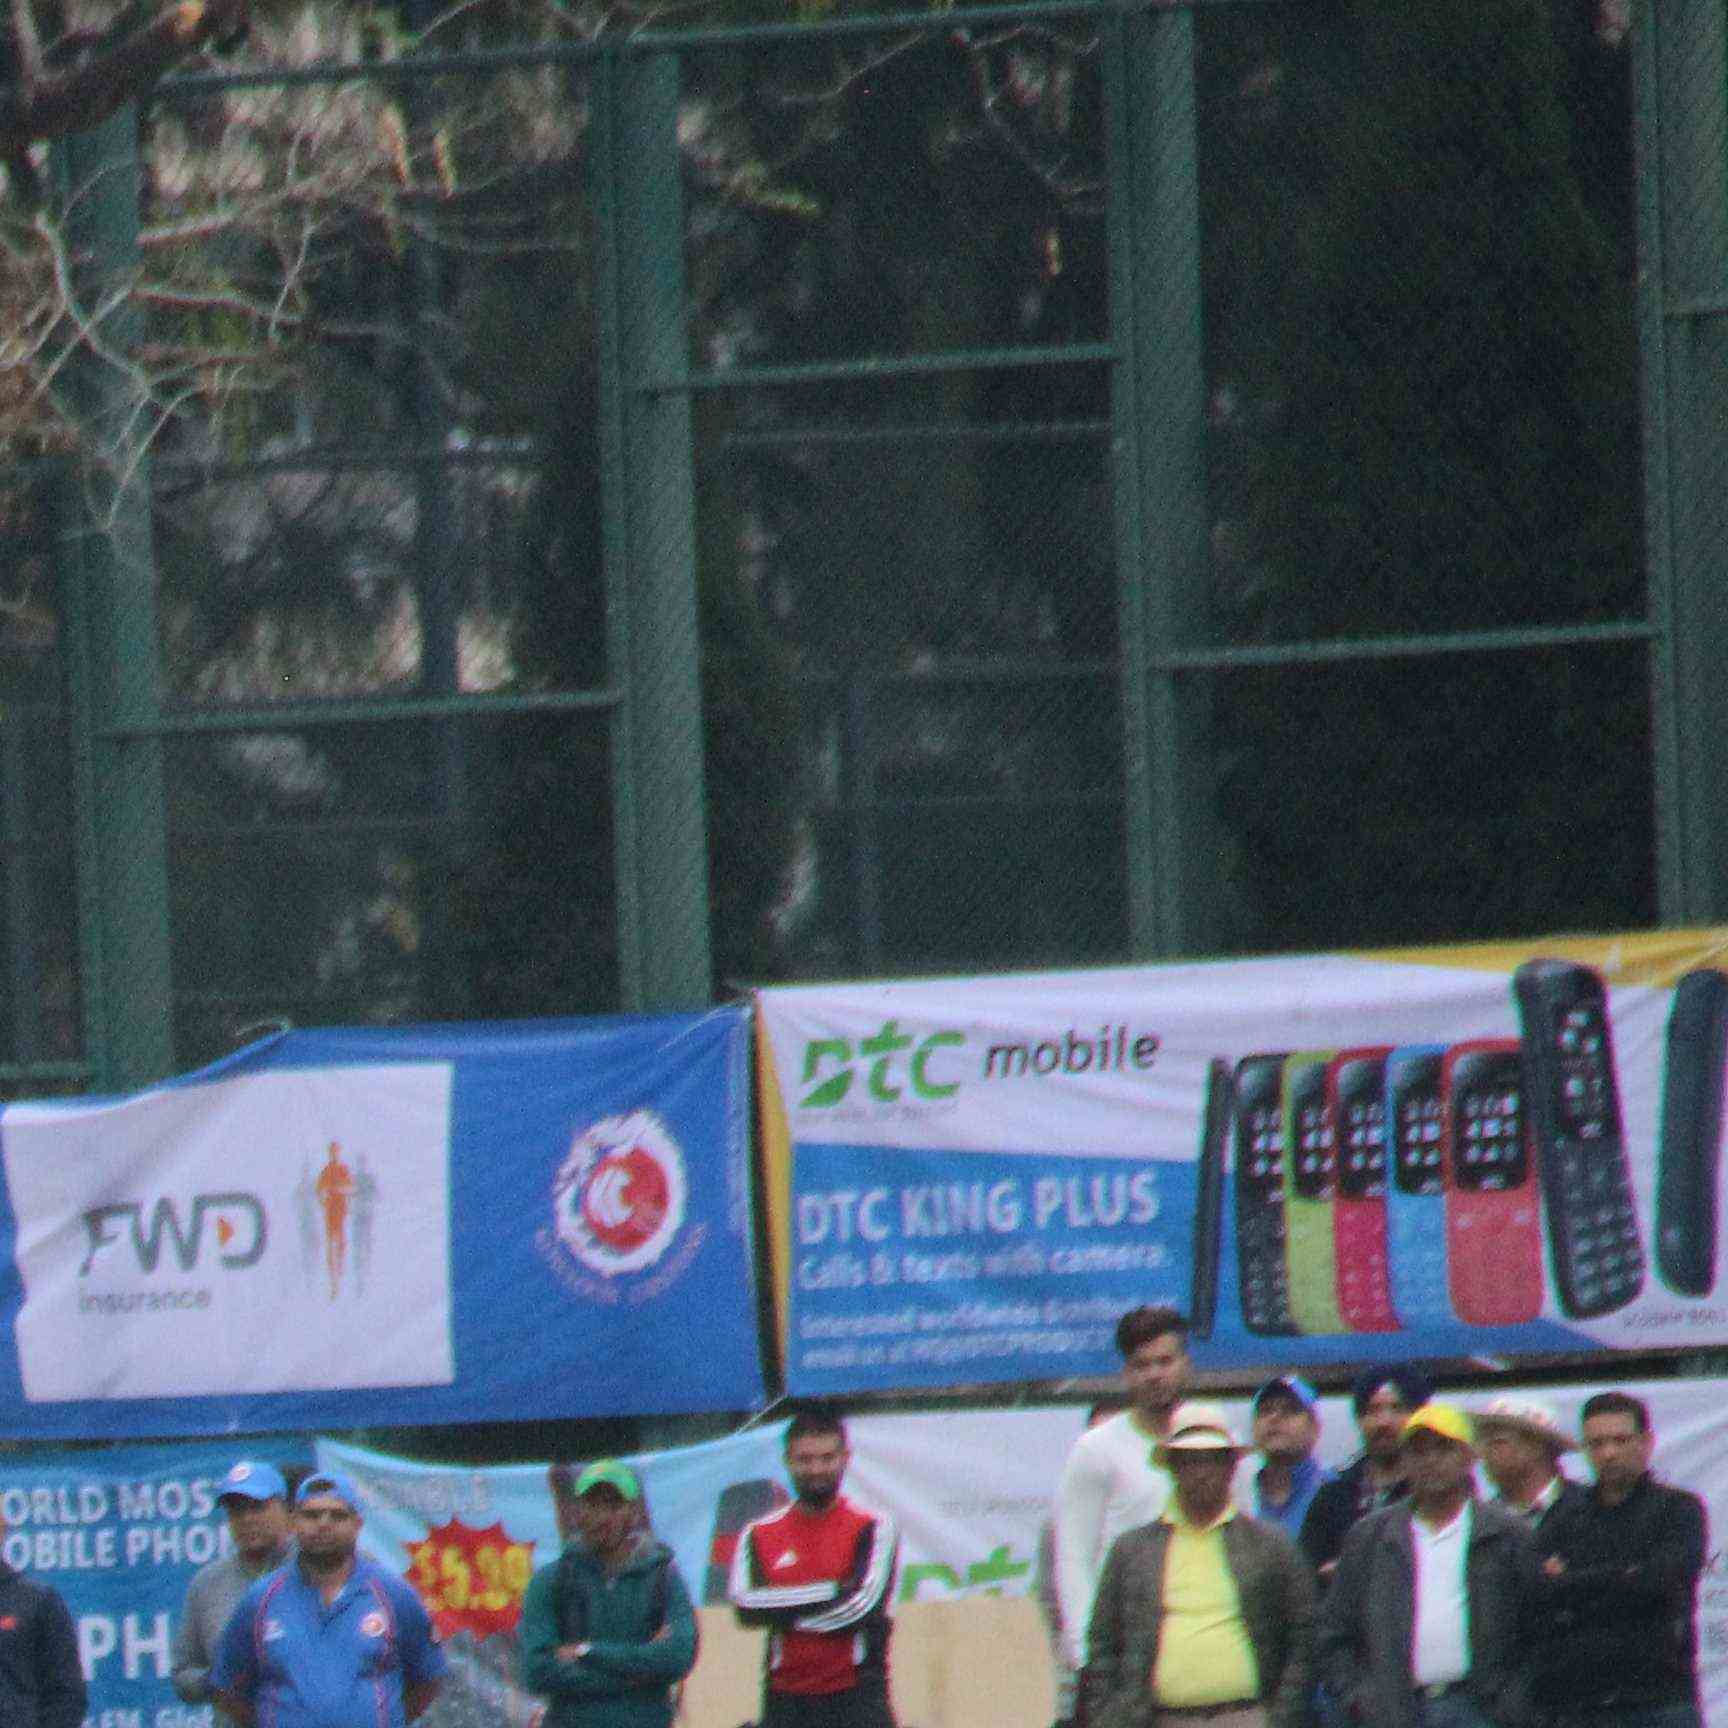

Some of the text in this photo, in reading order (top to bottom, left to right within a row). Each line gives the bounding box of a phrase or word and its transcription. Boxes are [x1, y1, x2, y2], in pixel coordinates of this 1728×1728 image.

[983, 1024, 1161, 1080] mobile
[79, 1191, 268, 1277] FWD
[797, 1171, 1162, 1245] DTC KING PLUS
[79, 1291, 211, 1313] insurance
[2, 1477, 220, 1529] ORLD MOS
[1, 1524, 117, 1573] OBILE
